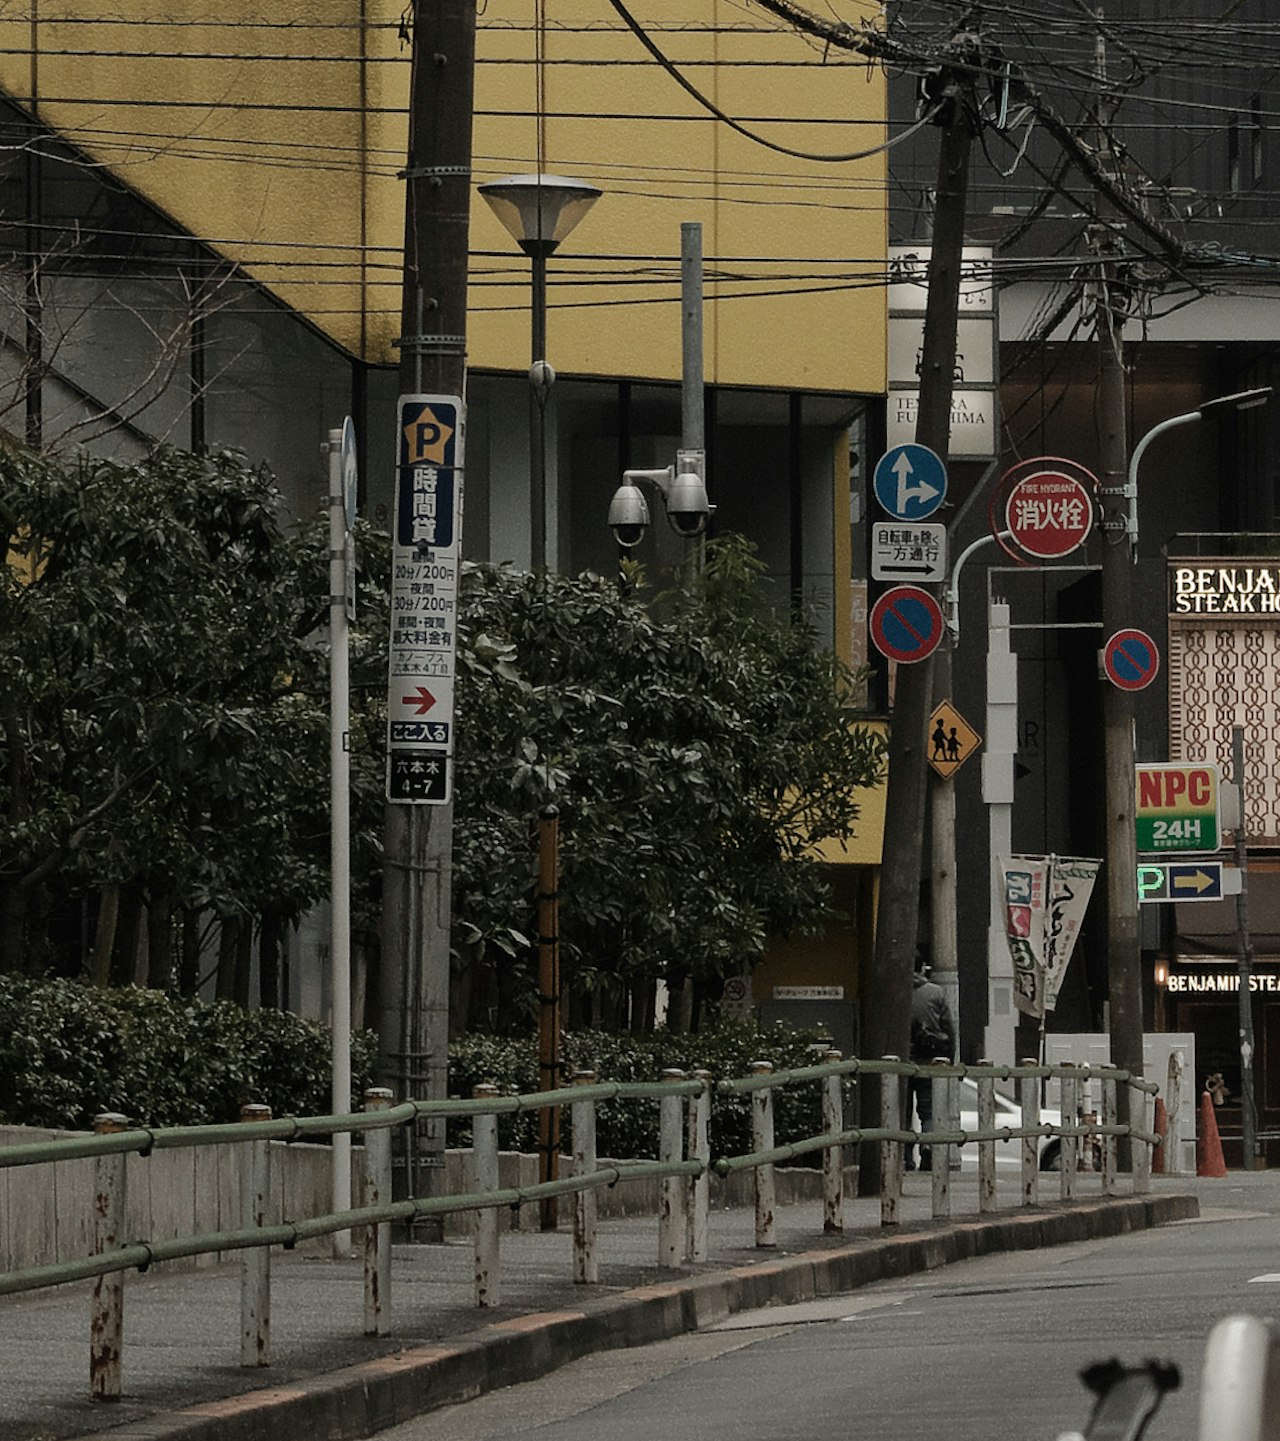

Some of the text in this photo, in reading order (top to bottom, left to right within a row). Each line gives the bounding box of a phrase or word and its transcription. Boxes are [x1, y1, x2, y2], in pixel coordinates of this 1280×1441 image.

[415, 422, 441, 458] P
[1015, 498, 1085, 531] 消火栓
[878, 529, 939, 545] 自転車を除く
[878, 546, 939, 561] 一方通行
[1175, 593, 1255, 613] STEAK
[393, 724, 446, 741] ここ入る
[396, 760, 440, 775] 六本木
[401, 779, 433, 794] 4-7
[1138, 770, 1211, 807] NPC
[1152, 819, 1201, 839] 24H
